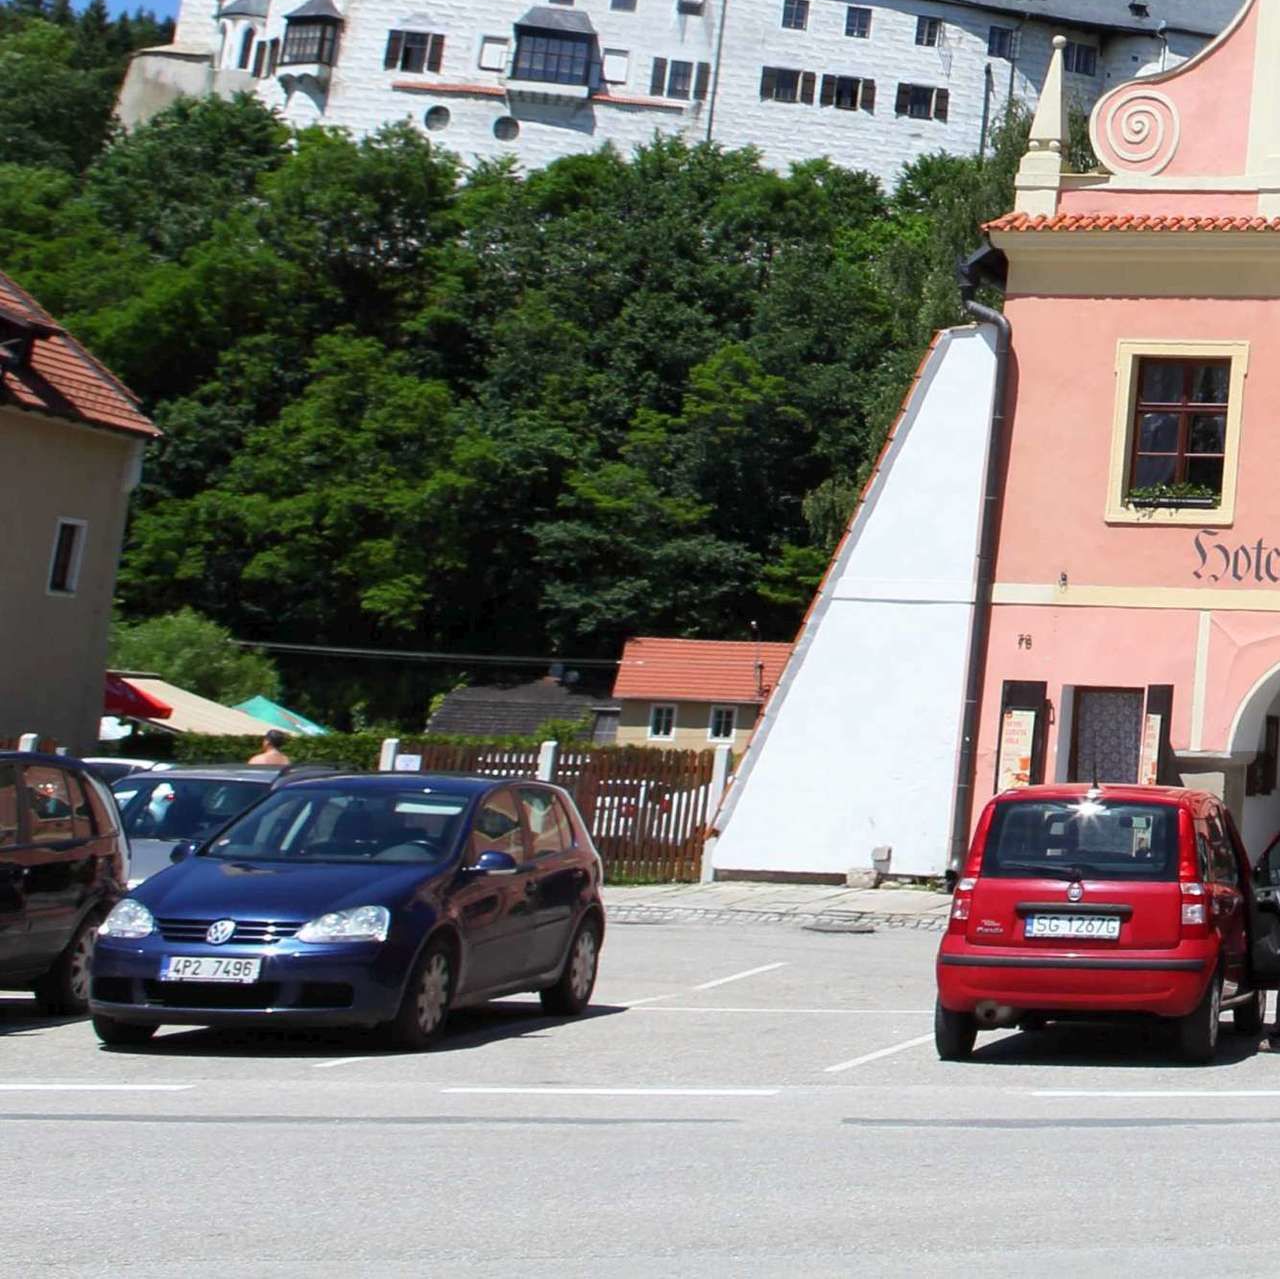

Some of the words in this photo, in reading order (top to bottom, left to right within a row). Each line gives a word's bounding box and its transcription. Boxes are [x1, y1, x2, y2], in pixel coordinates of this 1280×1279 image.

[1036, 916, 1060, 933] SG
[1067, 916, 1117, 935] 1267G
[173, 960, 203, 976] 4P2
[212, 960, 253, 977] 7496
